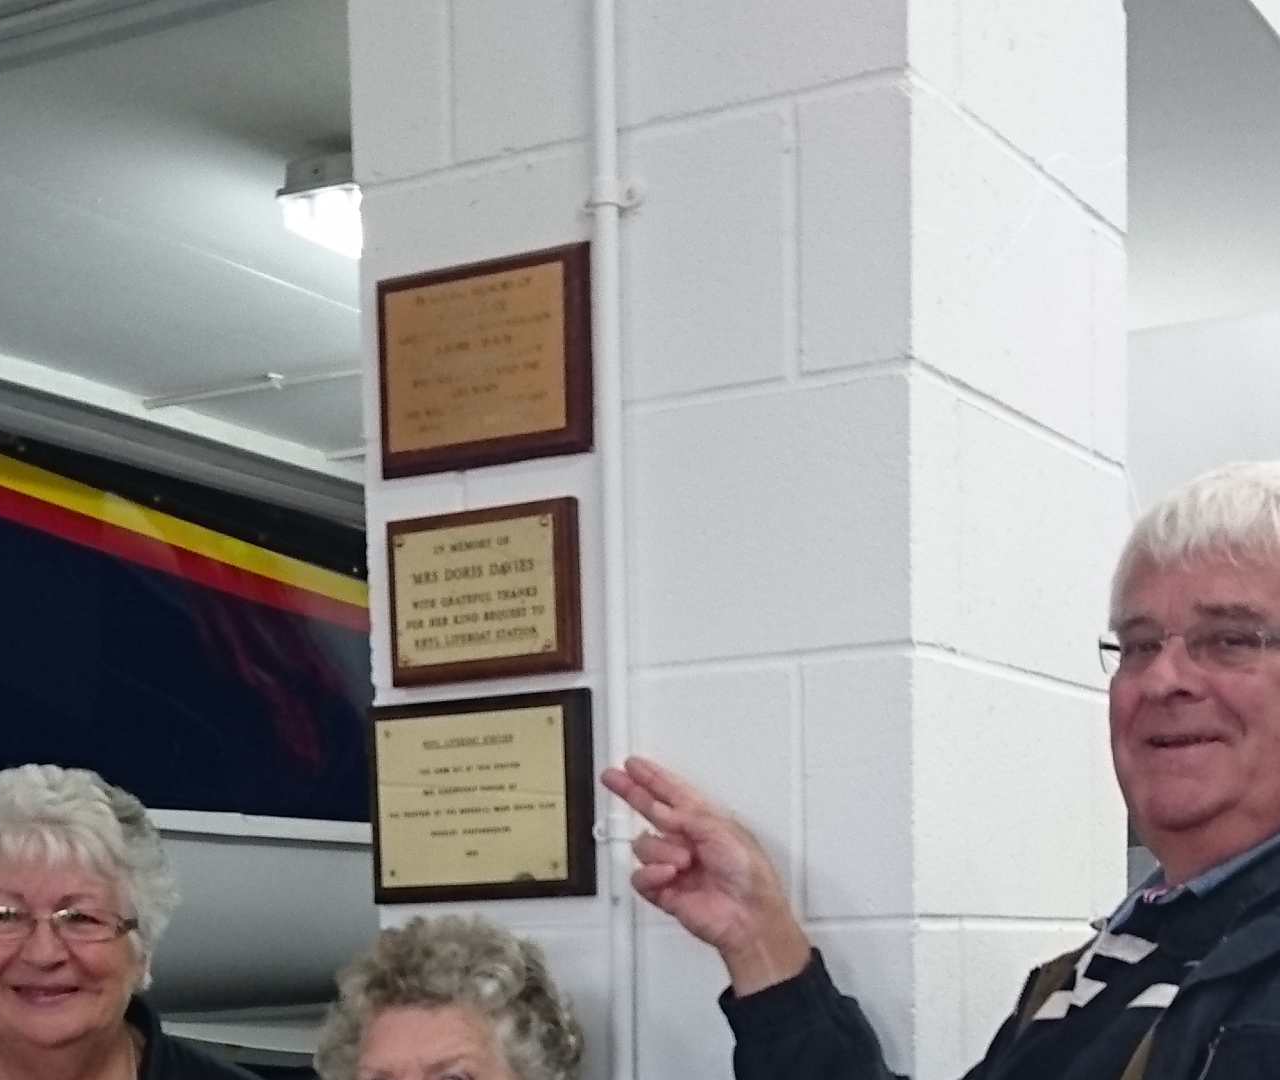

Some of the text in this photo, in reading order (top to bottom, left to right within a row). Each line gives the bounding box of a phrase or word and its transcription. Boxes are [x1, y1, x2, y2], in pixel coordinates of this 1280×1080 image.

[449, 538, 492, 553] MEMORY
[496, 535, 510, 546] OF
[412, 557, 535, 585] MRS DORIS DAVIES
[411, 585, 538, 611] WITH GRATEFUL THANKS
[453, 612, 479, 625] KIND
